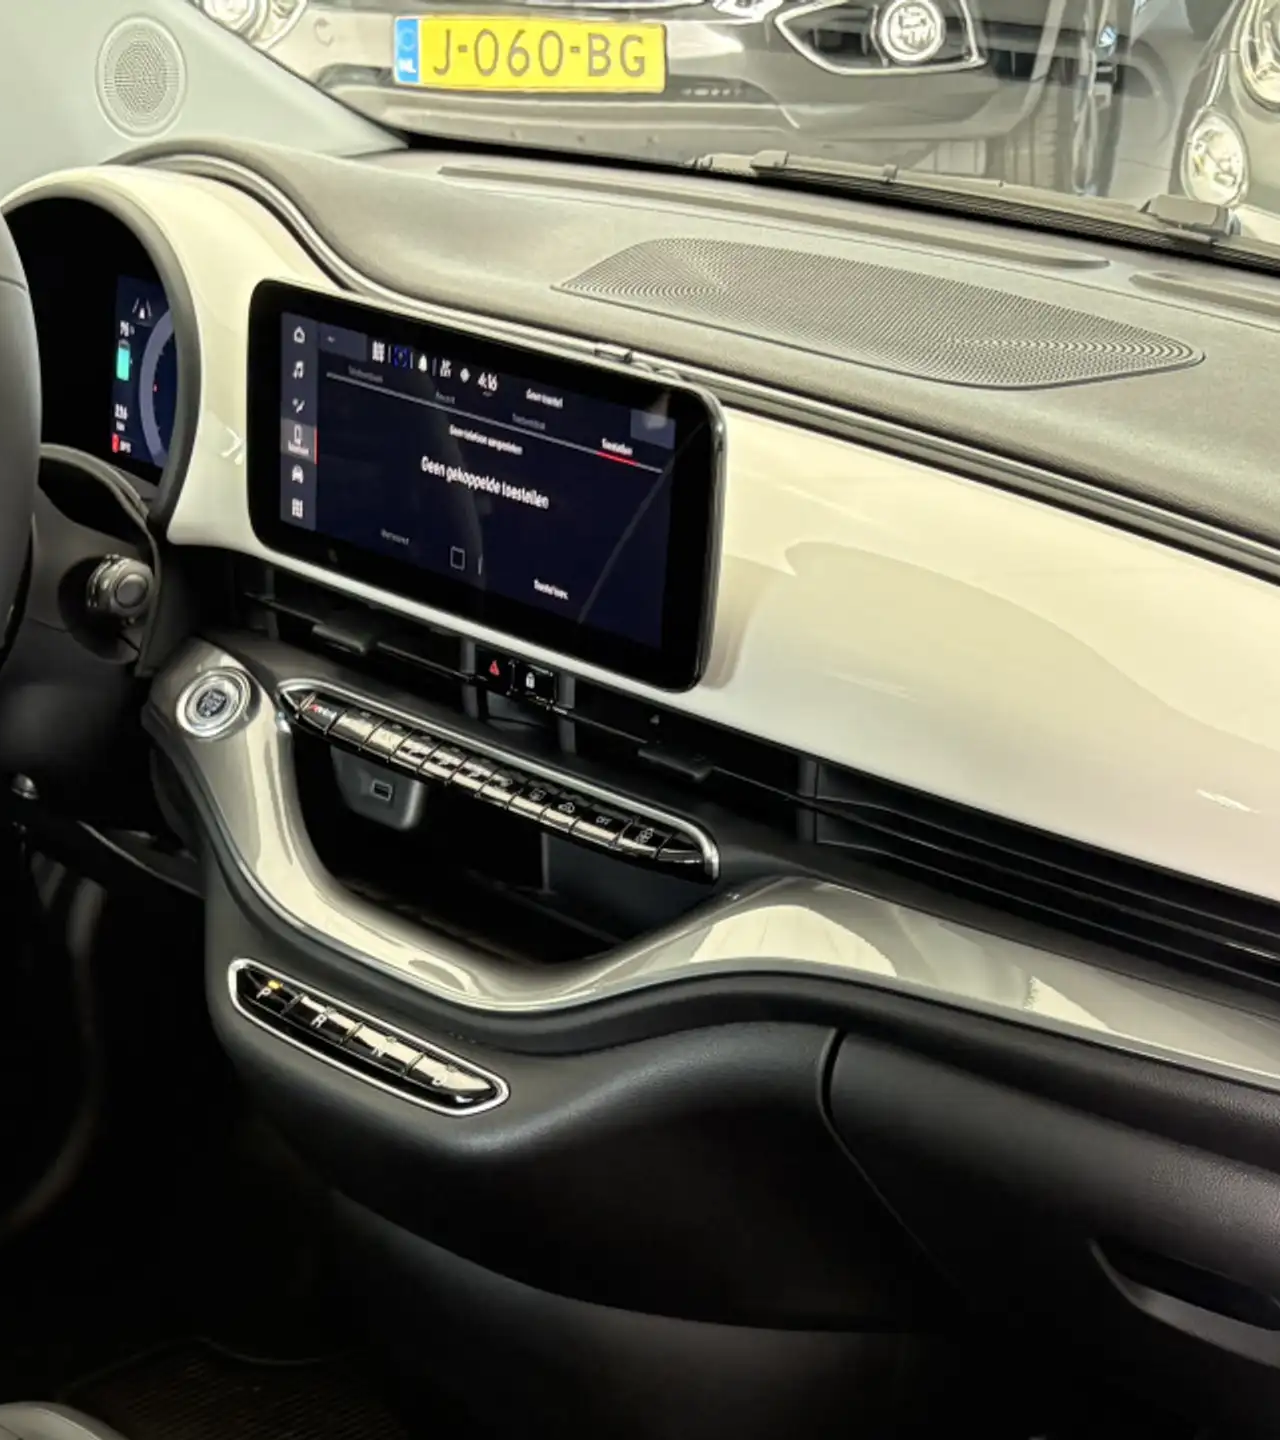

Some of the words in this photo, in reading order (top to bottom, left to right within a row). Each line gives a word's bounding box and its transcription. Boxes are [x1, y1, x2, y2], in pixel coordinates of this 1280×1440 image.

[432, 28, 647, 78] J-060-BG
[421, 455, 446, 478] Geen
[446, 466, 501, 496] gekoppelde
[256, 987, 271, 999] P
[310, 1013, 327, 1029] R
